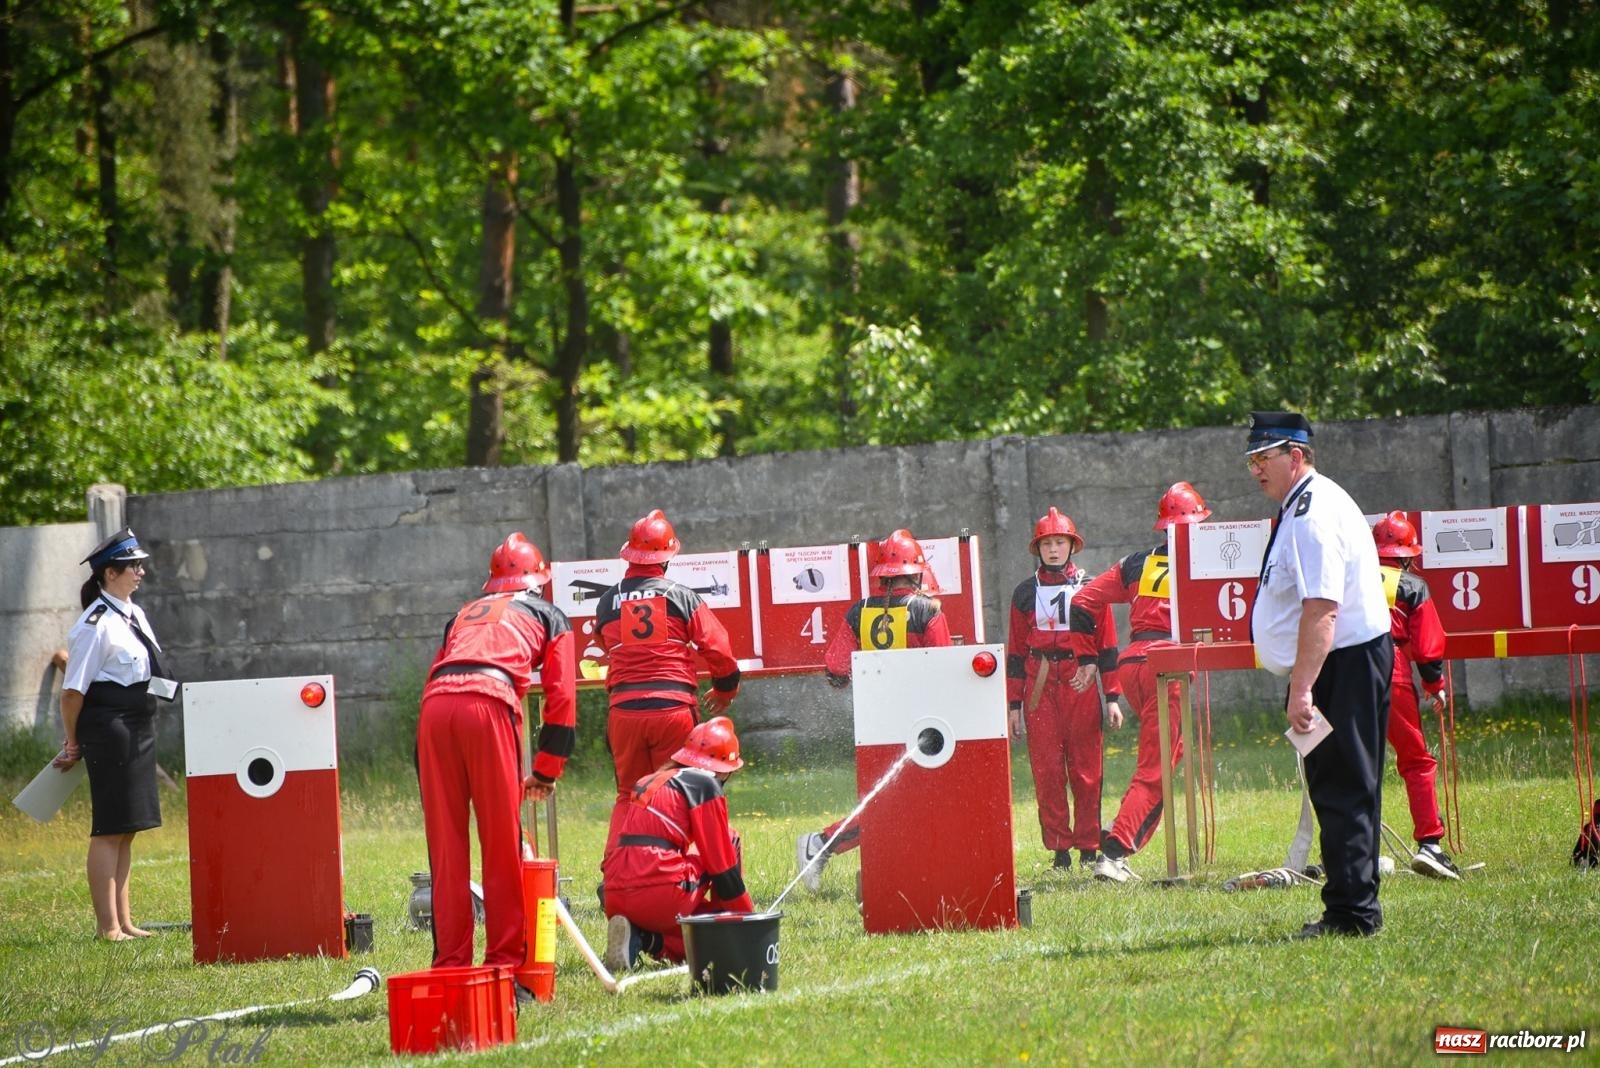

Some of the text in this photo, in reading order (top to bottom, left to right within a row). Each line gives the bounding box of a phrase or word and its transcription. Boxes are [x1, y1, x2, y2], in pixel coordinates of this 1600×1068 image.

[1152, 561, 1169, 593] 7
[1452, 571, 1480, 611] 8
[1571, 564, 1600, 605] 9
[1050, 591, 1066, 625] 1
[1217, 581, 1247, 621] 6
[631, 604, 654, 639] 3
[800, 606, 827, 644] 4
[870, 613, 894, 650] 6
